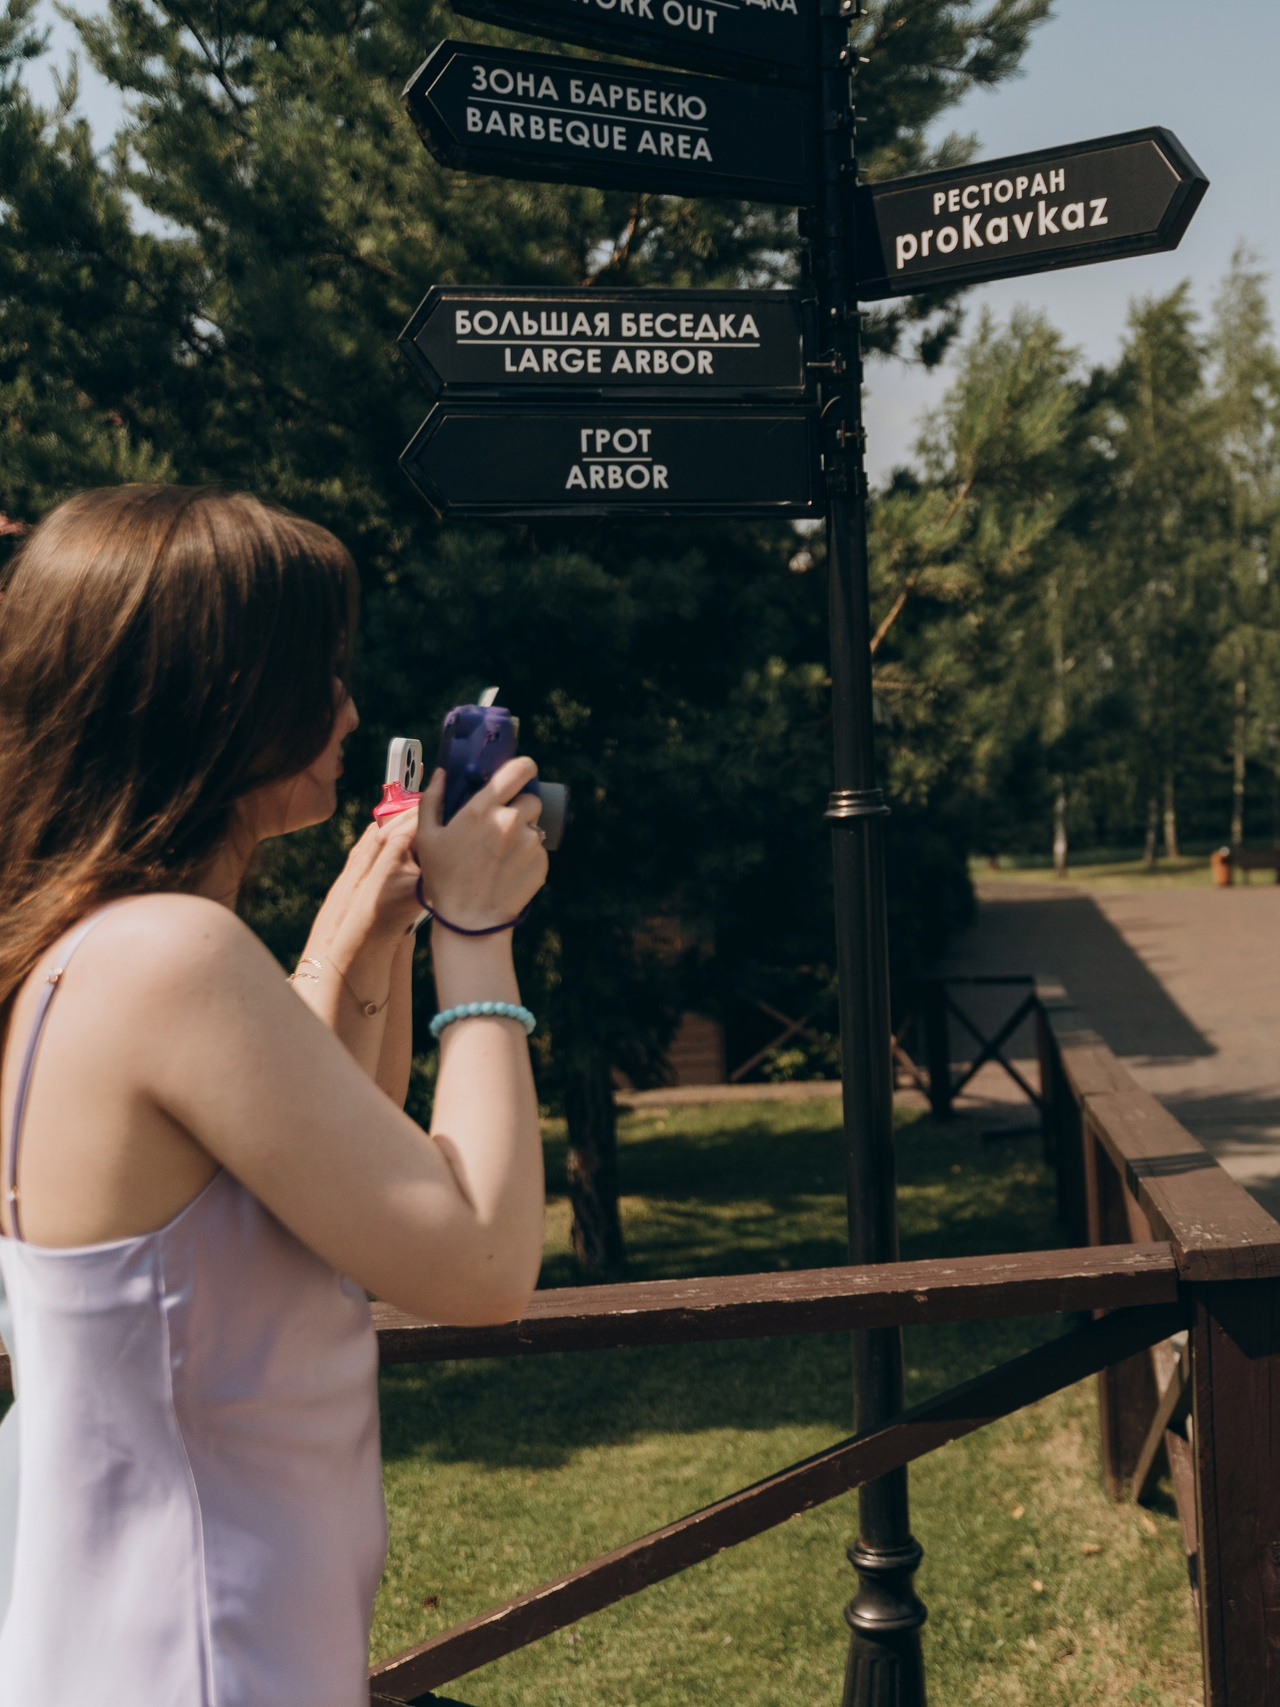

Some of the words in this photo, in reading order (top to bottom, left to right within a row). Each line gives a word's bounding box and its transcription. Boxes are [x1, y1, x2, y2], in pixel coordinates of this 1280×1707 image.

[662, 0, 718, 34] OUT
[471, 65, 559, 101] ЗОНА
[570, 79, 707, 121] БАРБЕКЮ
[466, 107, 627, 151] BARBEQUE
[637, 130, 713, 162] AREA
[933, 168, 1065, 215] РЕСТОРАН
[896, 197, 1109, 270] proKavkaz
[455, 309, 610, 337] БОЛЬШАЯ
[621, 313, 760, 342] БЕСЕДКА
[504, 347, 602, 374] LARGE
[610, 349, 714, 375] ARBOR
[580, 428, 652, 454] ГРОТ
[565, 464, 669, 490] ARBOR
